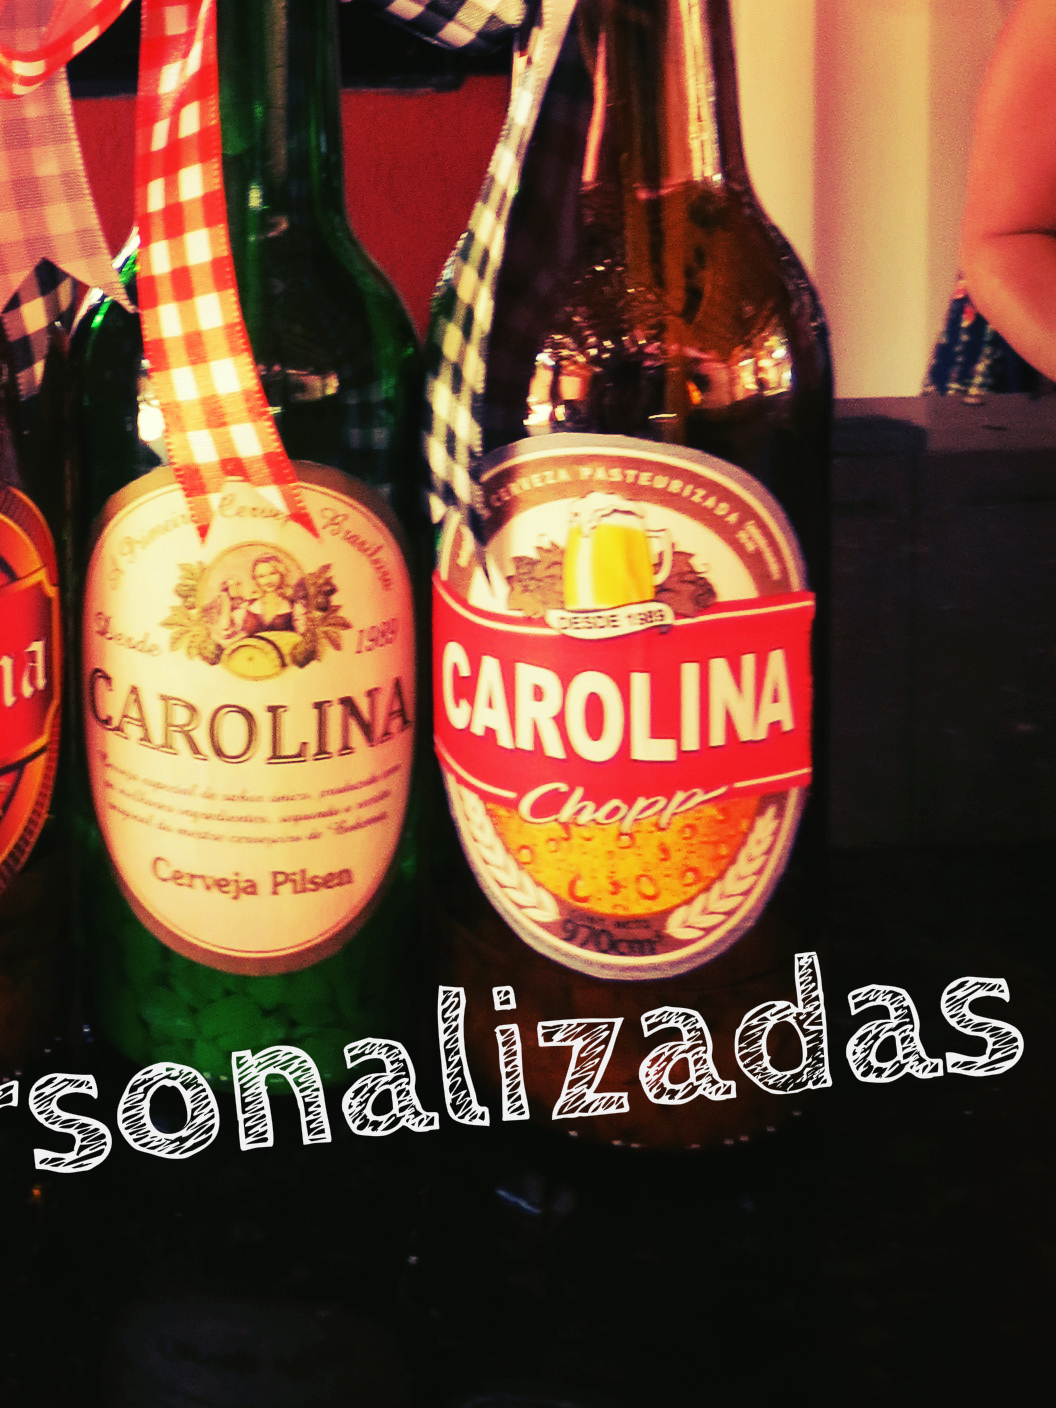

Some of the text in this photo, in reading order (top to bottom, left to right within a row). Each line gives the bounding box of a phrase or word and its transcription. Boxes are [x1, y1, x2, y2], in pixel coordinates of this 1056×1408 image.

[578, 466, 740, 525] PASTEURIZADA
[559, 614, 620, 630] DESDE
[89, 667, 413, 766] CAROLINA
[442, 640, 795, 763] CAROLINA
[517, 780, 728, 833] Chopp
[151, 855, 354, 900] Cerveja Pilsen
